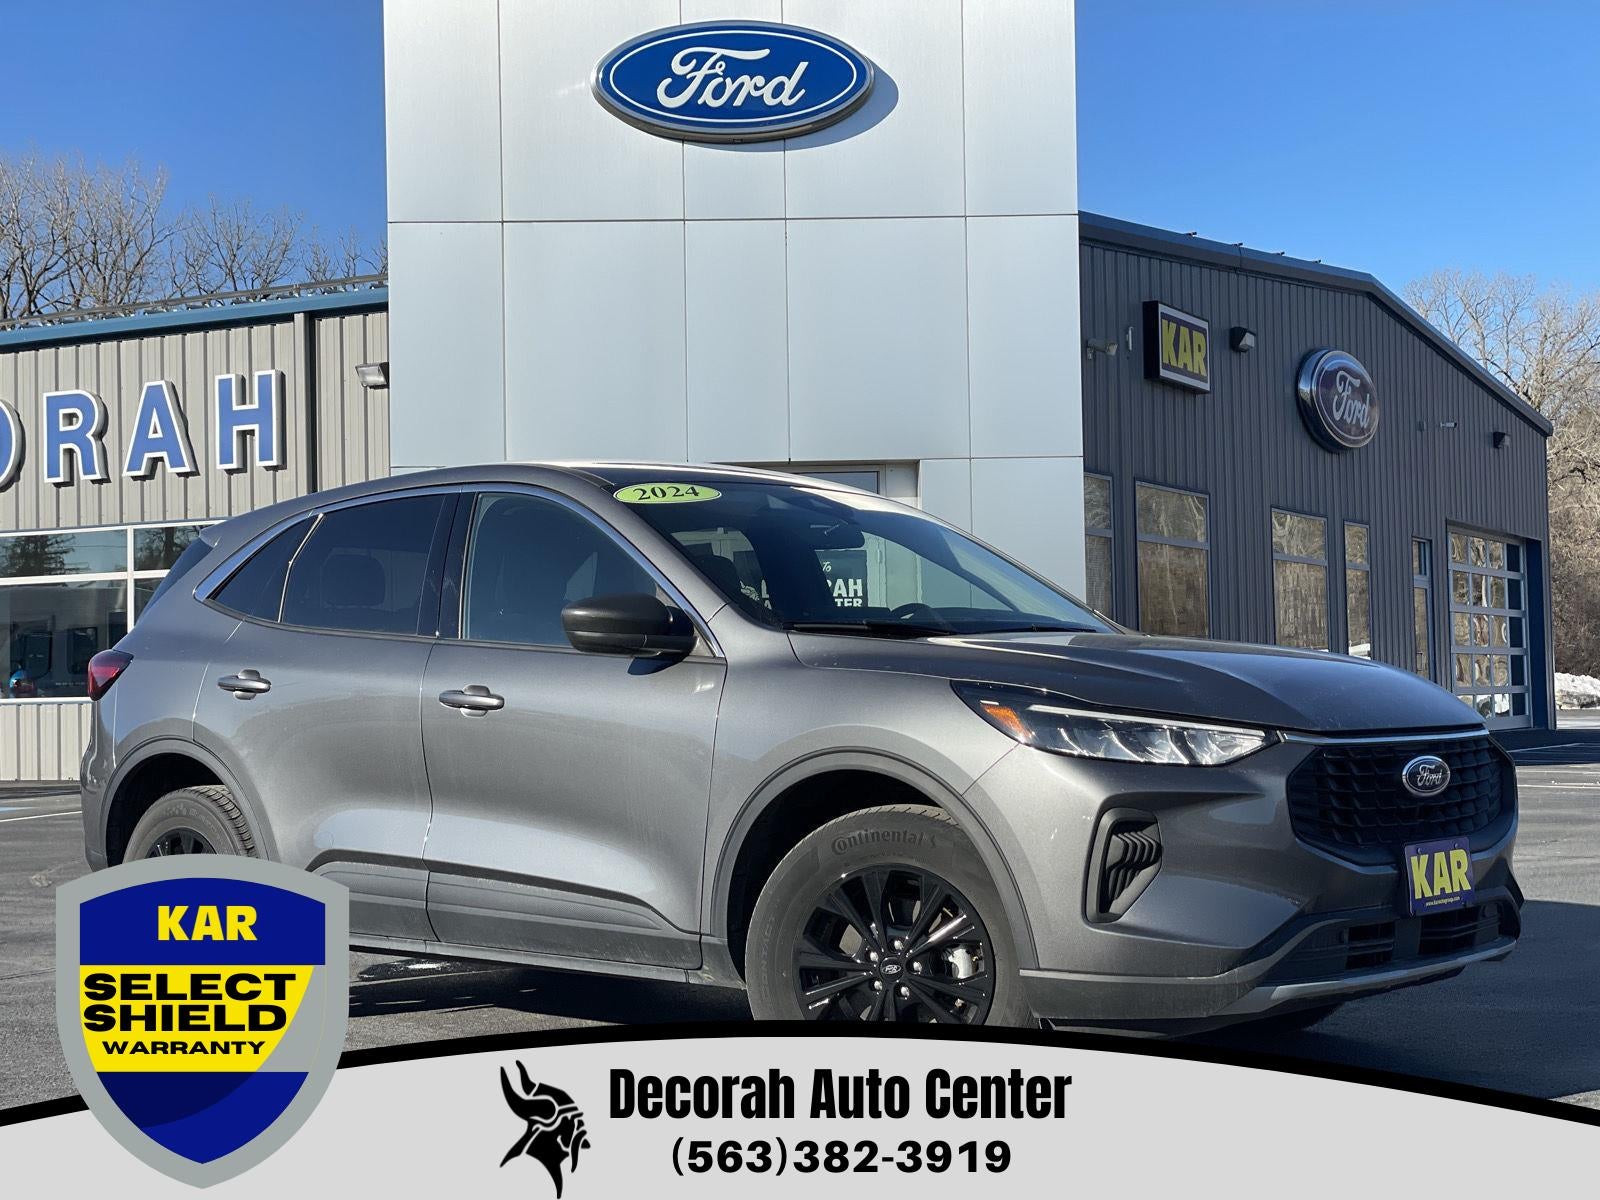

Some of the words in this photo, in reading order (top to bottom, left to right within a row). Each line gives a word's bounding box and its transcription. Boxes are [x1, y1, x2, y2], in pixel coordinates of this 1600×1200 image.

[656, 46, 809, 109] Ford
[1161, 318, 1208, 376] KAR
[1332, 370, 1371, 429] Ford
[632, 484, 700, 501] 2024
[1416, 764, 1442, 787] Ford
[831, 828, 925, 856] Continental
[1410, 849, 1472, 900] KAR
